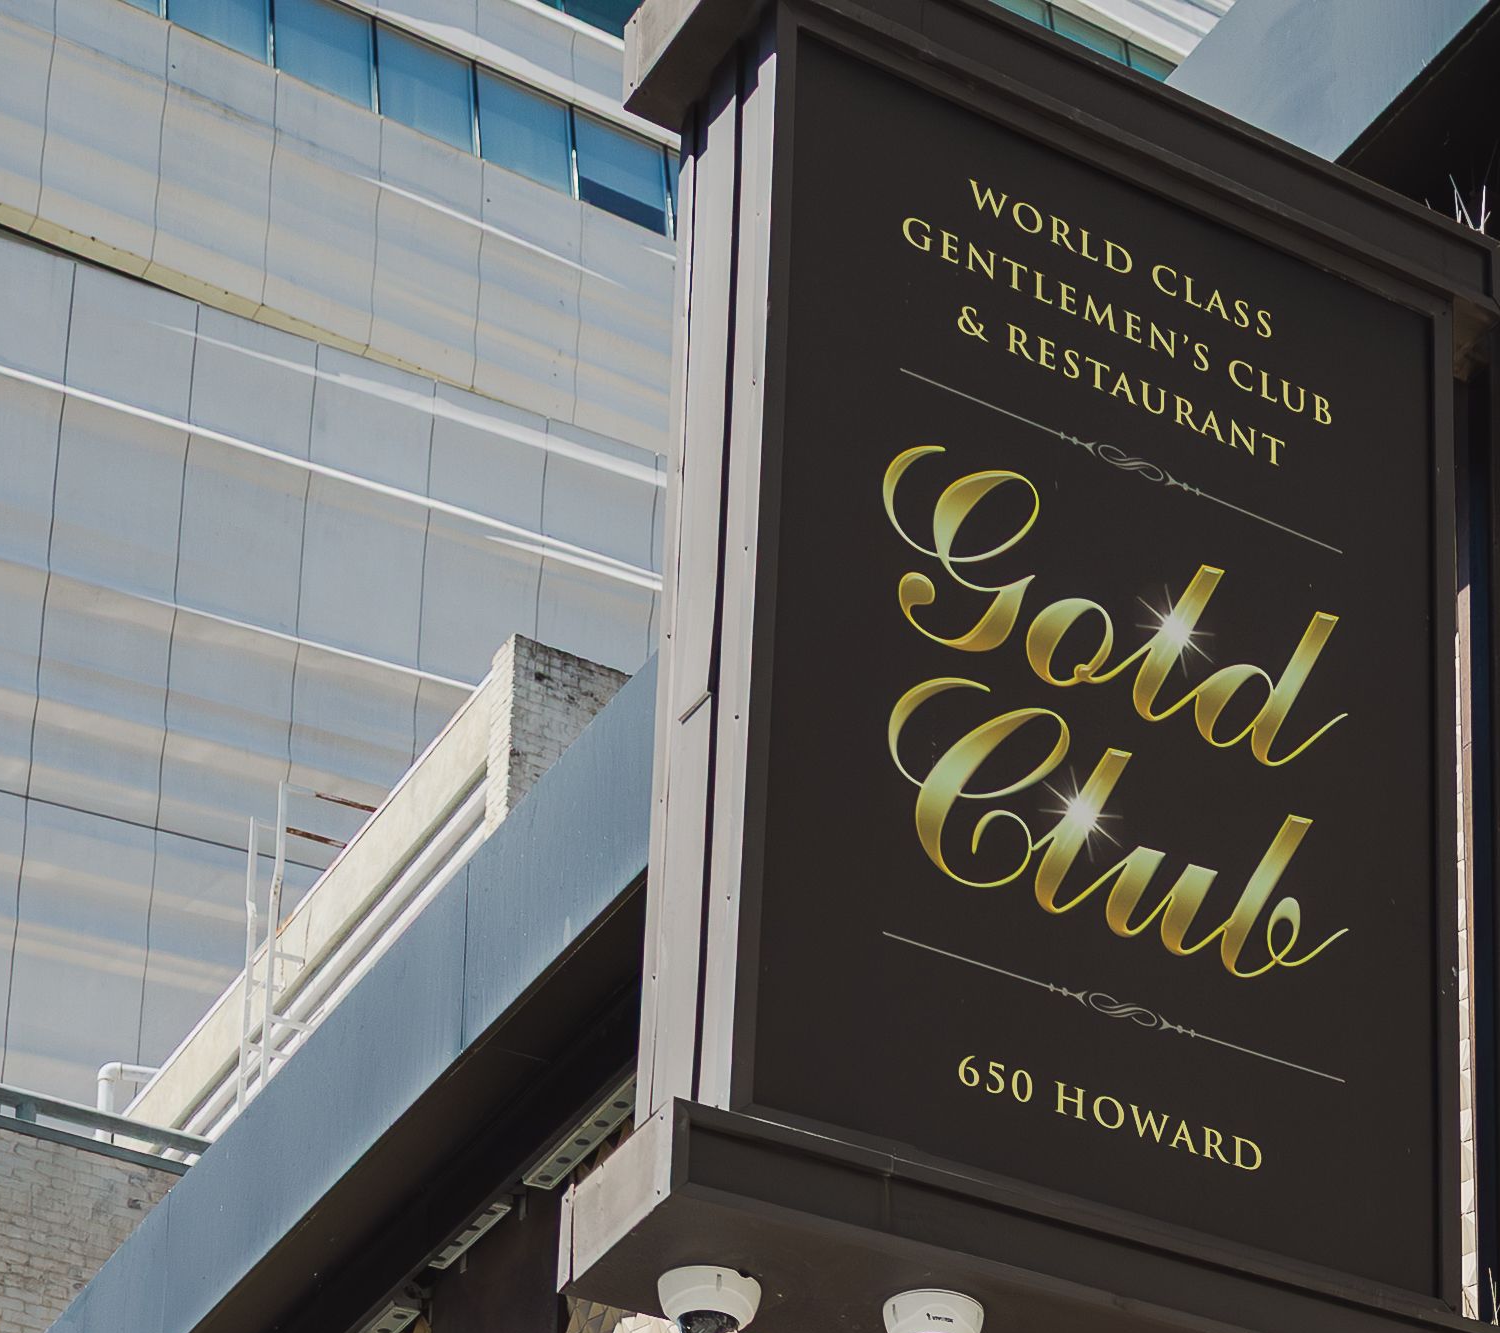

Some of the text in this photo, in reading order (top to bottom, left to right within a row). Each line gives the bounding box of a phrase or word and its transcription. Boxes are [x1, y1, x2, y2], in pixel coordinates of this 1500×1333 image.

[902, 216, 1335, 426] GENTLEMEN'S CLUB
[969, 178, 1274, 340] WORLD CLASS
[957, 305, 1286, 468] & RESTAURANT
[883, 444, 1348, 767] Gold
[887, 677, 1350, 979] Club
[957, 1055, 1263, 1172] 650 HOWARD
